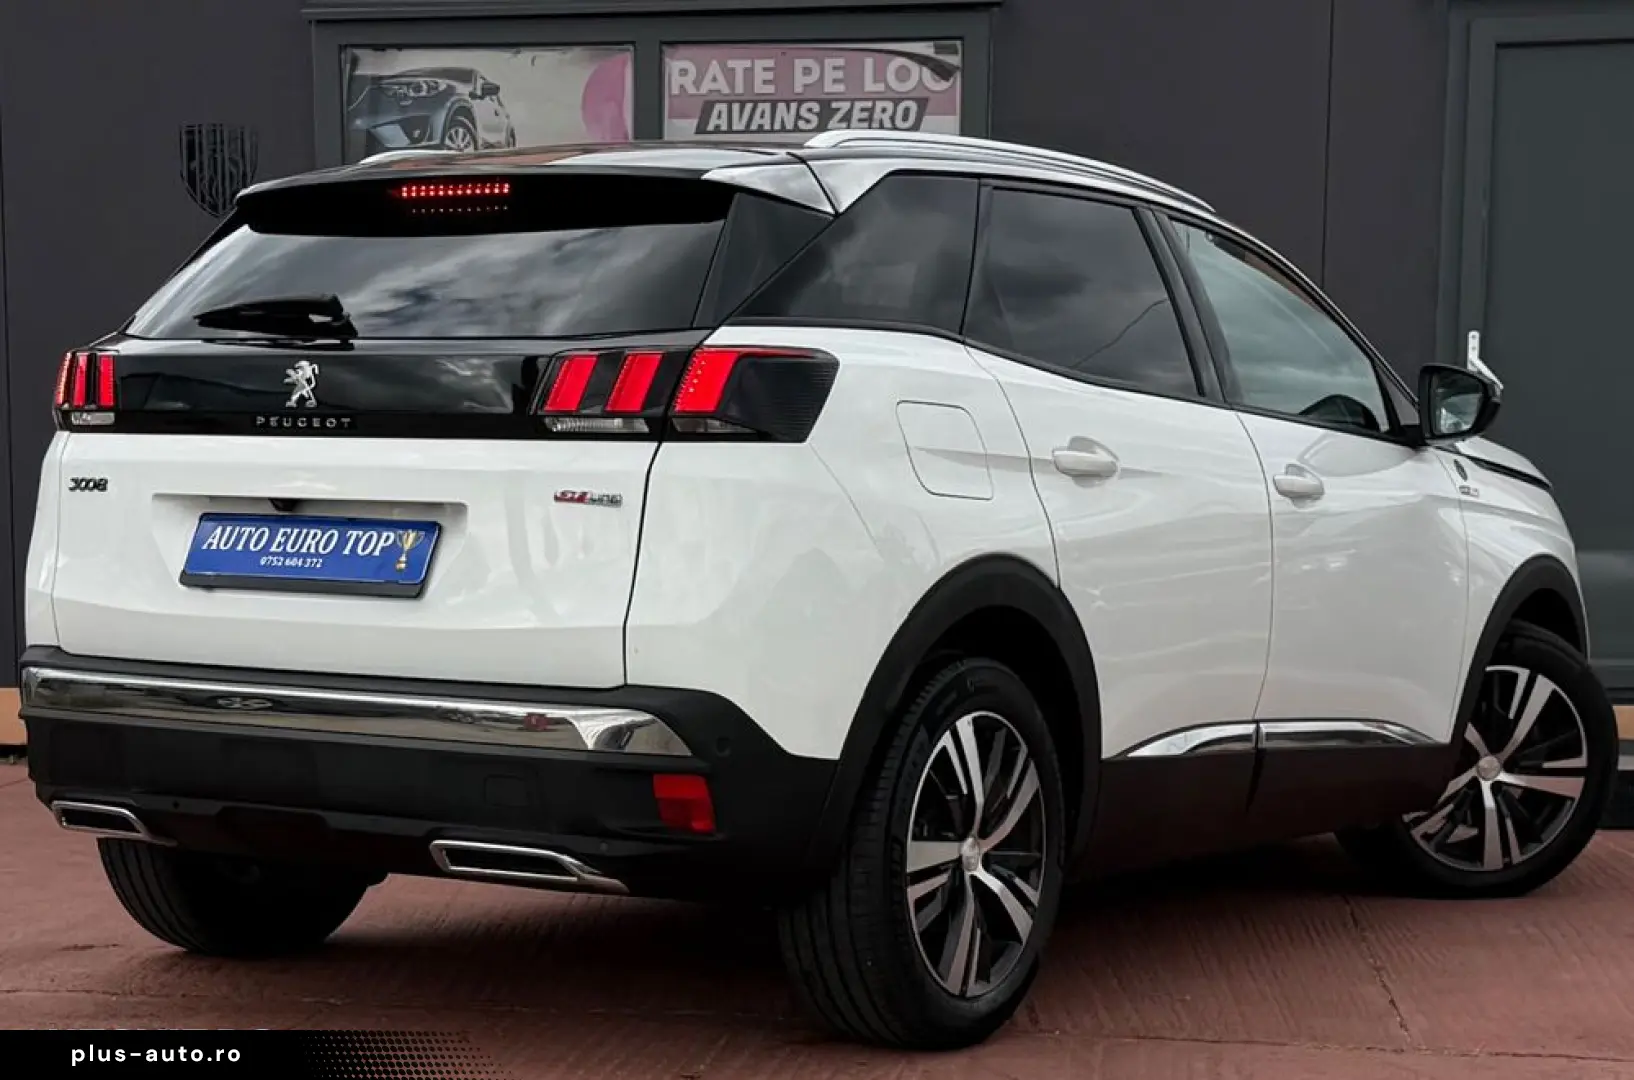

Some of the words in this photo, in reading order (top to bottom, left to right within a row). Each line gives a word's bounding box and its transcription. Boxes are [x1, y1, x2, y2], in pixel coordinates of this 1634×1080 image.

[670, 56, 776, 95] RATE
[793, 57, 847, 94] PE
[706, 102, 819, 132] AVANS
[827, 100, 919, 130] ZERO
[255, 416, 352, 428] PEUGEOT
[202, 525, 271, 553] AUTO
[269, 527, 340, 556] EURO
[342, 530, 396, 557] TOP
